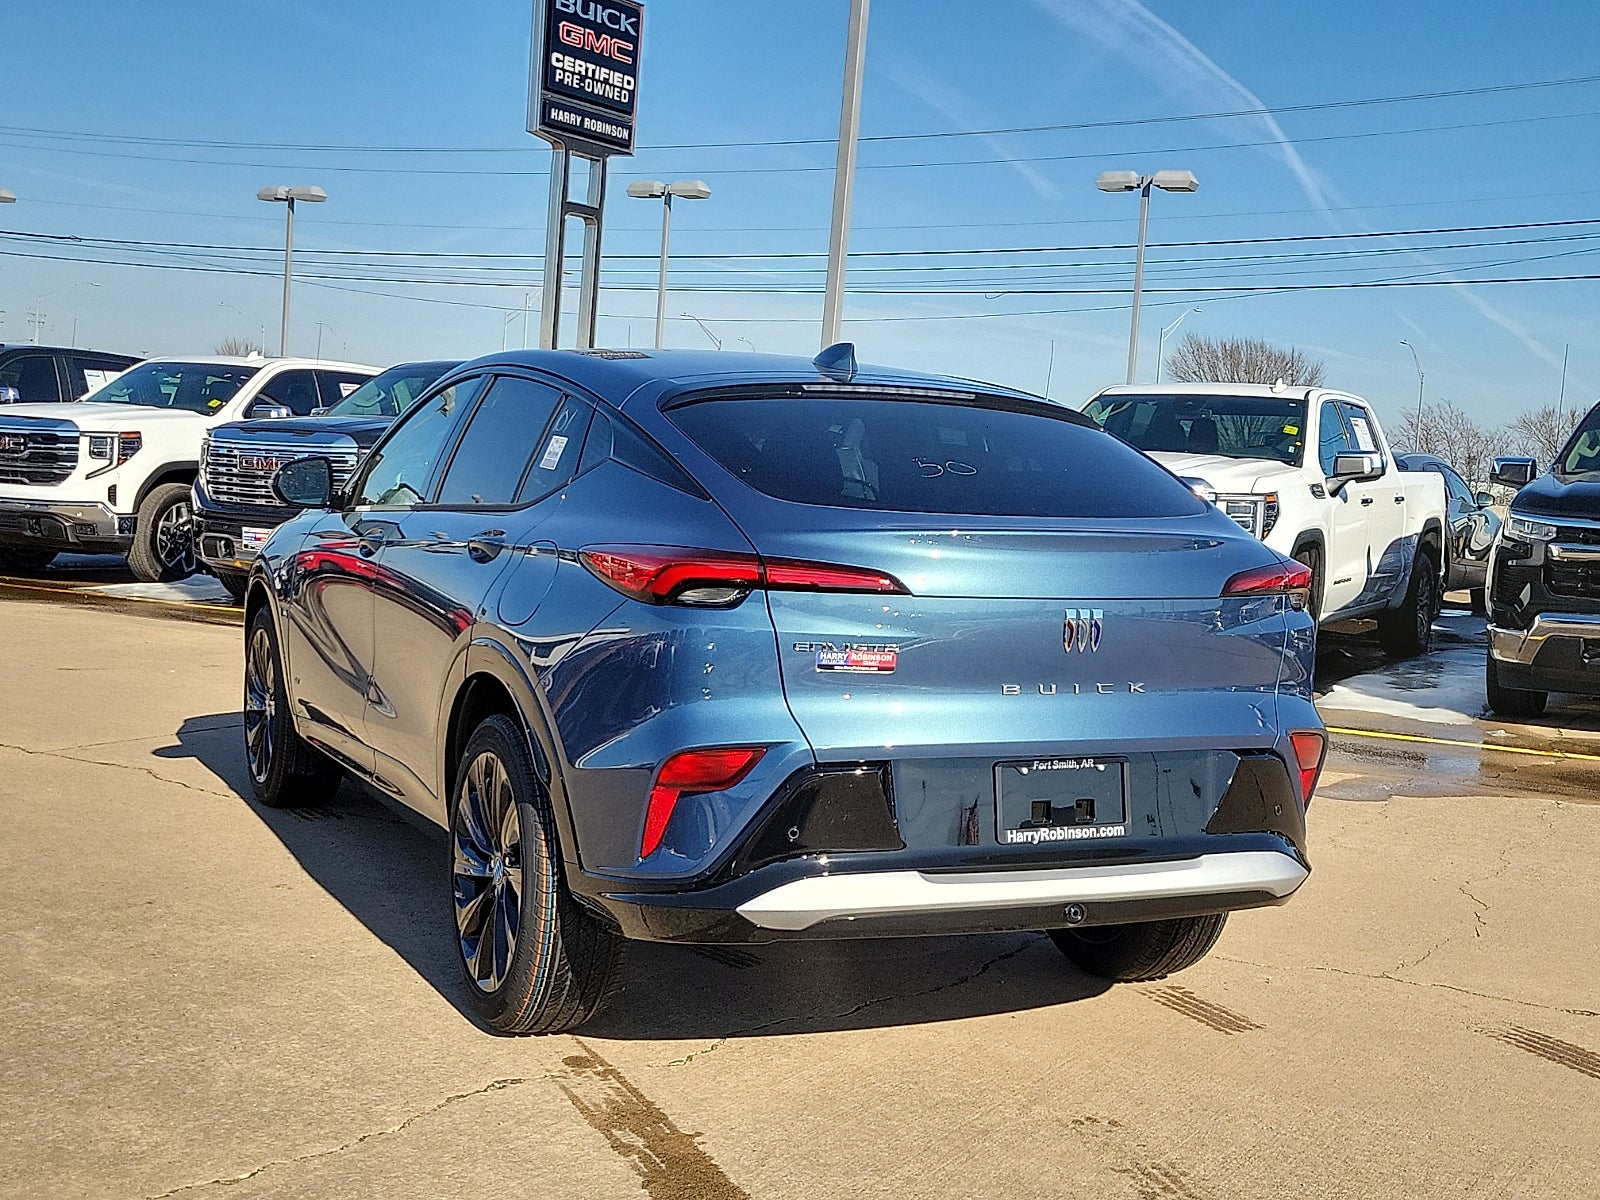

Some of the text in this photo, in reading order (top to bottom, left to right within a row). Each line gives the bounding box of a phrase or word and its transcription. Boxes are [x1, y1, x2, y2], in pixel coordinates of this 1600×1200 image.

[555, 0, 638, 36] BUICK
[559, 21, 633, 64] GMC
[551, 52, 635, 91] CERTIFIED
[555, 69, 629, 103] PRE-OWNED
[551, 108, 629, 140] HARRY ROBINSON
[820, 652, 893, 662] HARRY ROBINSON
[1001, 682, 1147, 695] BUICK
[1033, 759, 1094, 770] Fort Smith, AR
[1007, 825, 1125, 844] HarryRobinson.com
